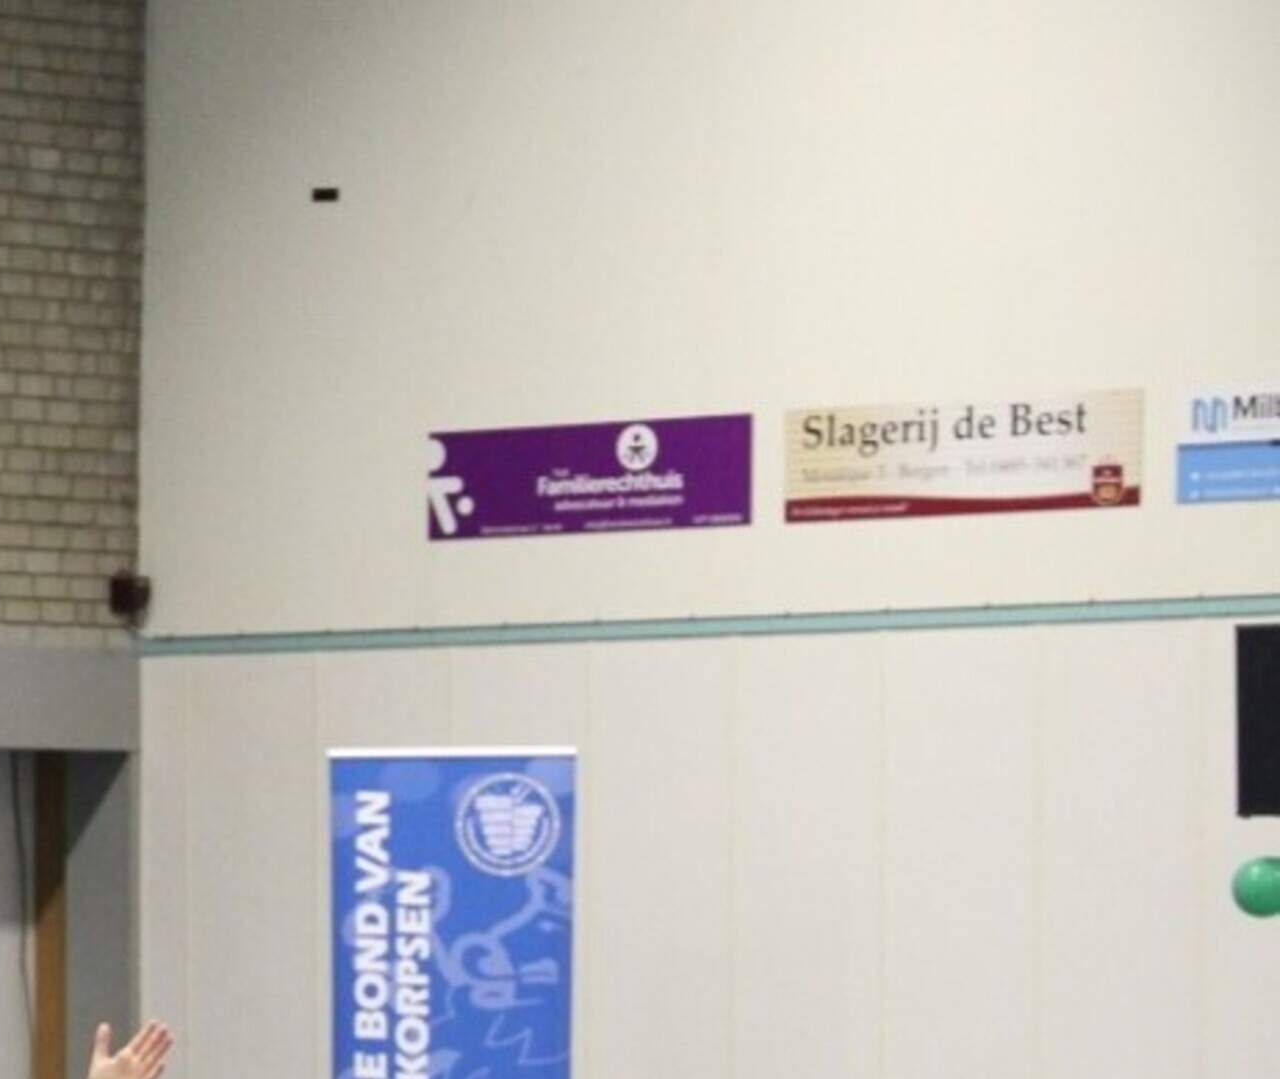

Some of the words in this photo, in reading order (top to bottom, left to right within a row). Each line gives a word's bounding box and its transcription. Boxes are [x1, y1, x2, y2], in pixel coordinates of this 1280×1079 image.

[802, 407, 940, 458] Slagerij
[952, 404, 997, 441] de
[1009, 402, 1087, 437] Best
[354, 790, 391, 892] VAN
[353, 902, 389, 1040] BOND
